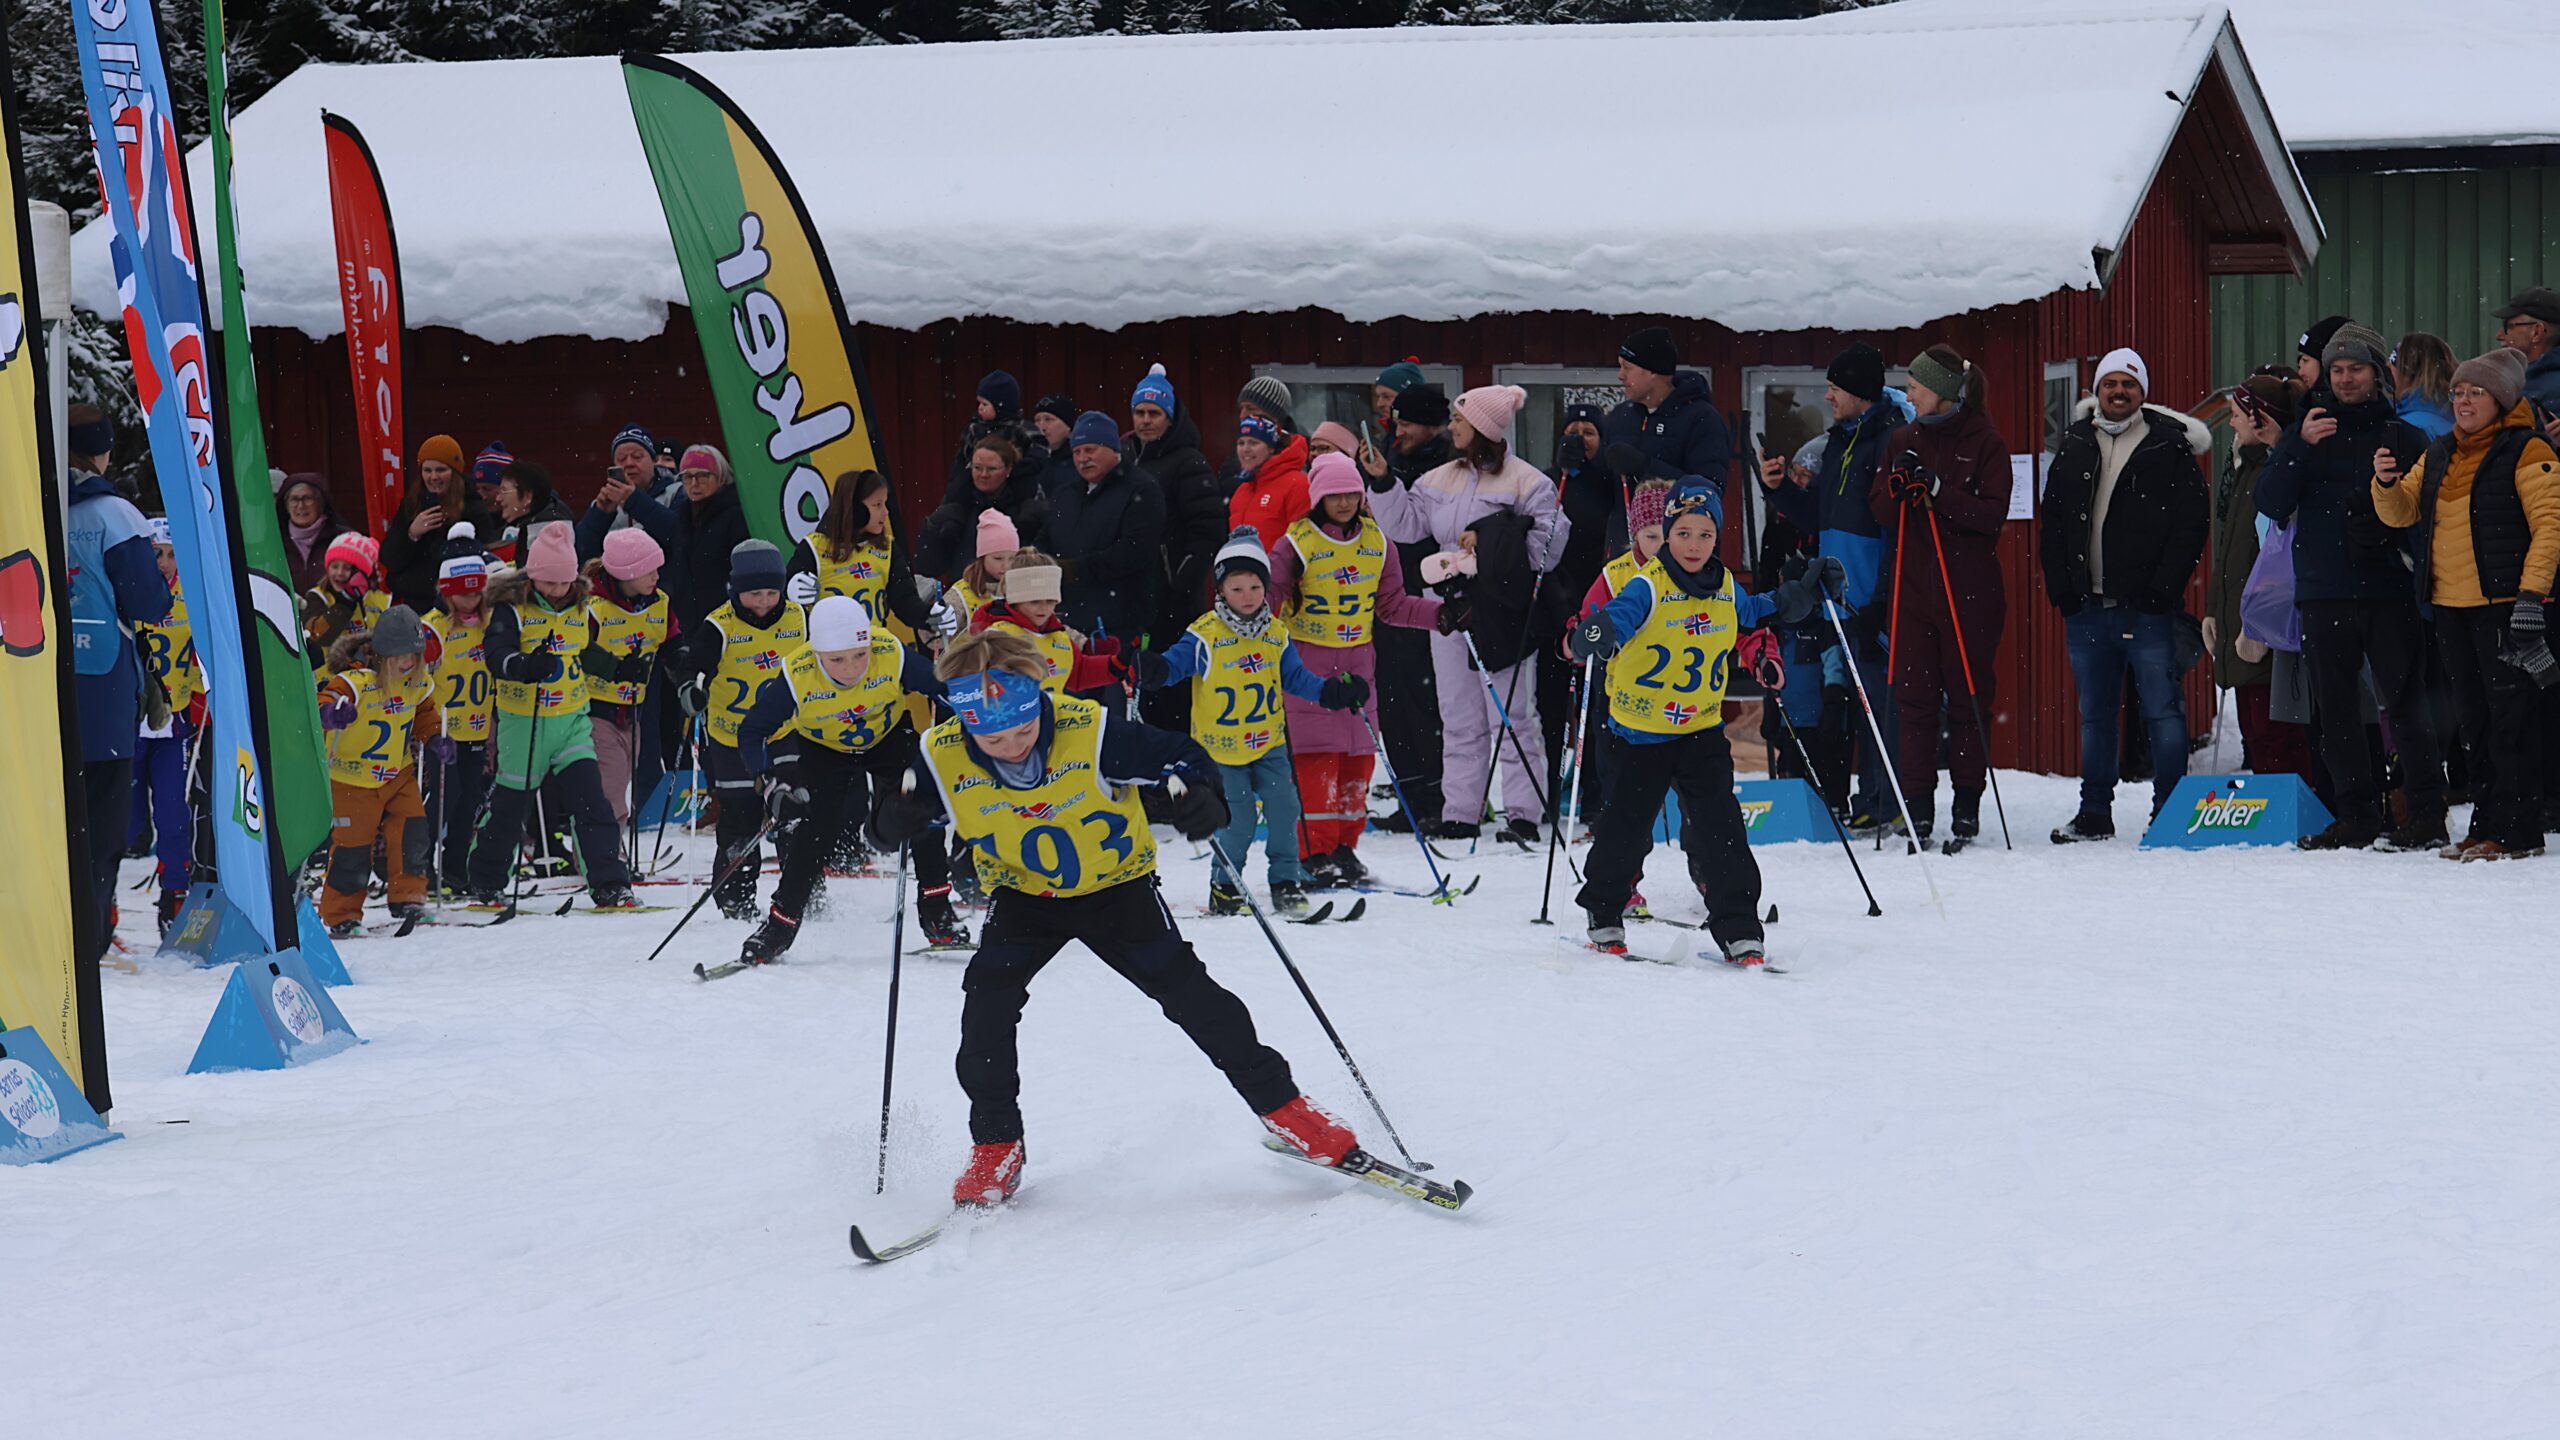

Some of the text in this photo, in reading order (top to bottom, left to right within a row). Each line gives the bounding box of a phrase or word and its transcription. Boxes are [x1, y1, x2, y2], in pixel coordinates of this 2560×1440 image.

[1635, 644, 1728, 693] 236
[804, 691, 836, 704] joker
[1045, 759, 1089, 787] joker
[2186, 790, 2260, 836] joker
